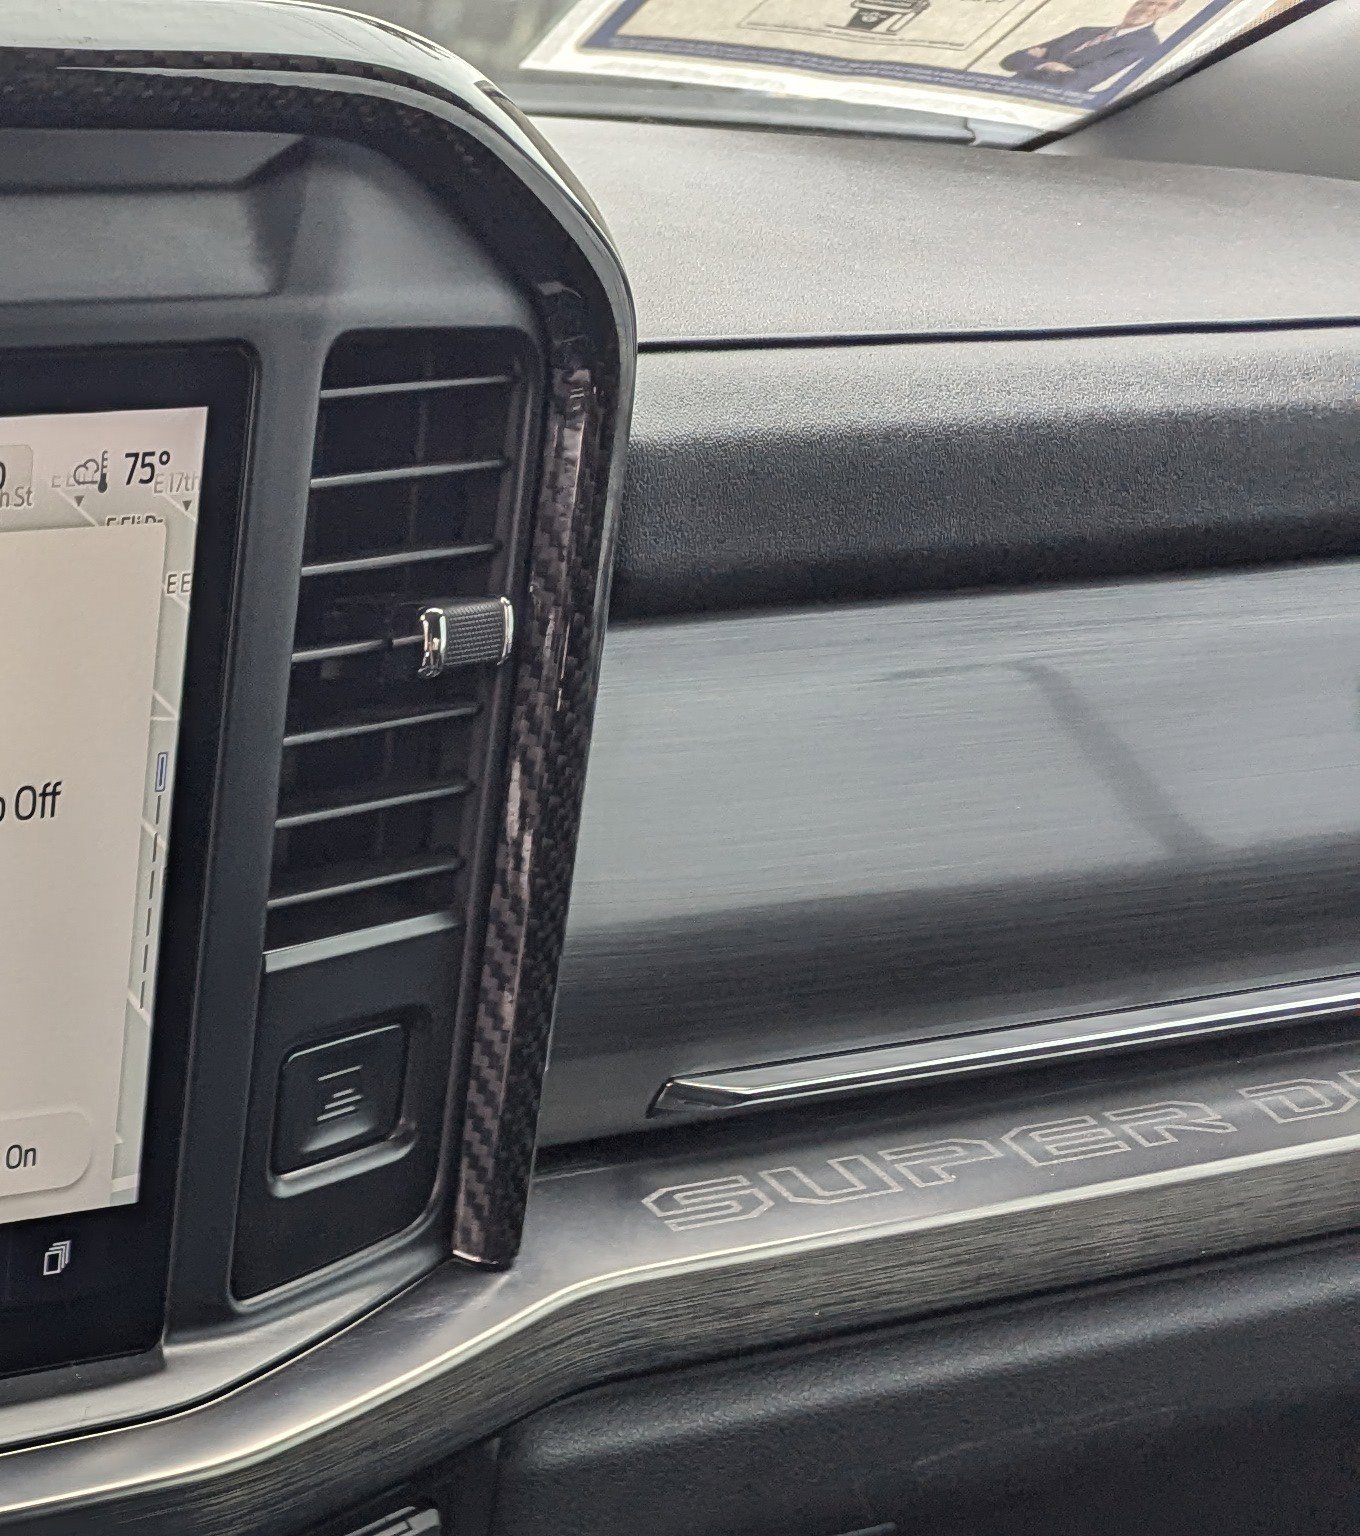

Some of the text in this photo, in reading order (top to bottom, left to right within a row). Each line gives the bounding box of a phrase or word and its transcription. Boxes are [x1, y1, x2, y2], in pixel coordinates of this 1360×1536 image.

[13, 486, 32, 507] St
[167, 574, 177, 594] E
[14, 782, 63, 821] Off
[7, 1143, 37, 1171] On
[642, 1100, 1238, 1232] SUPER
